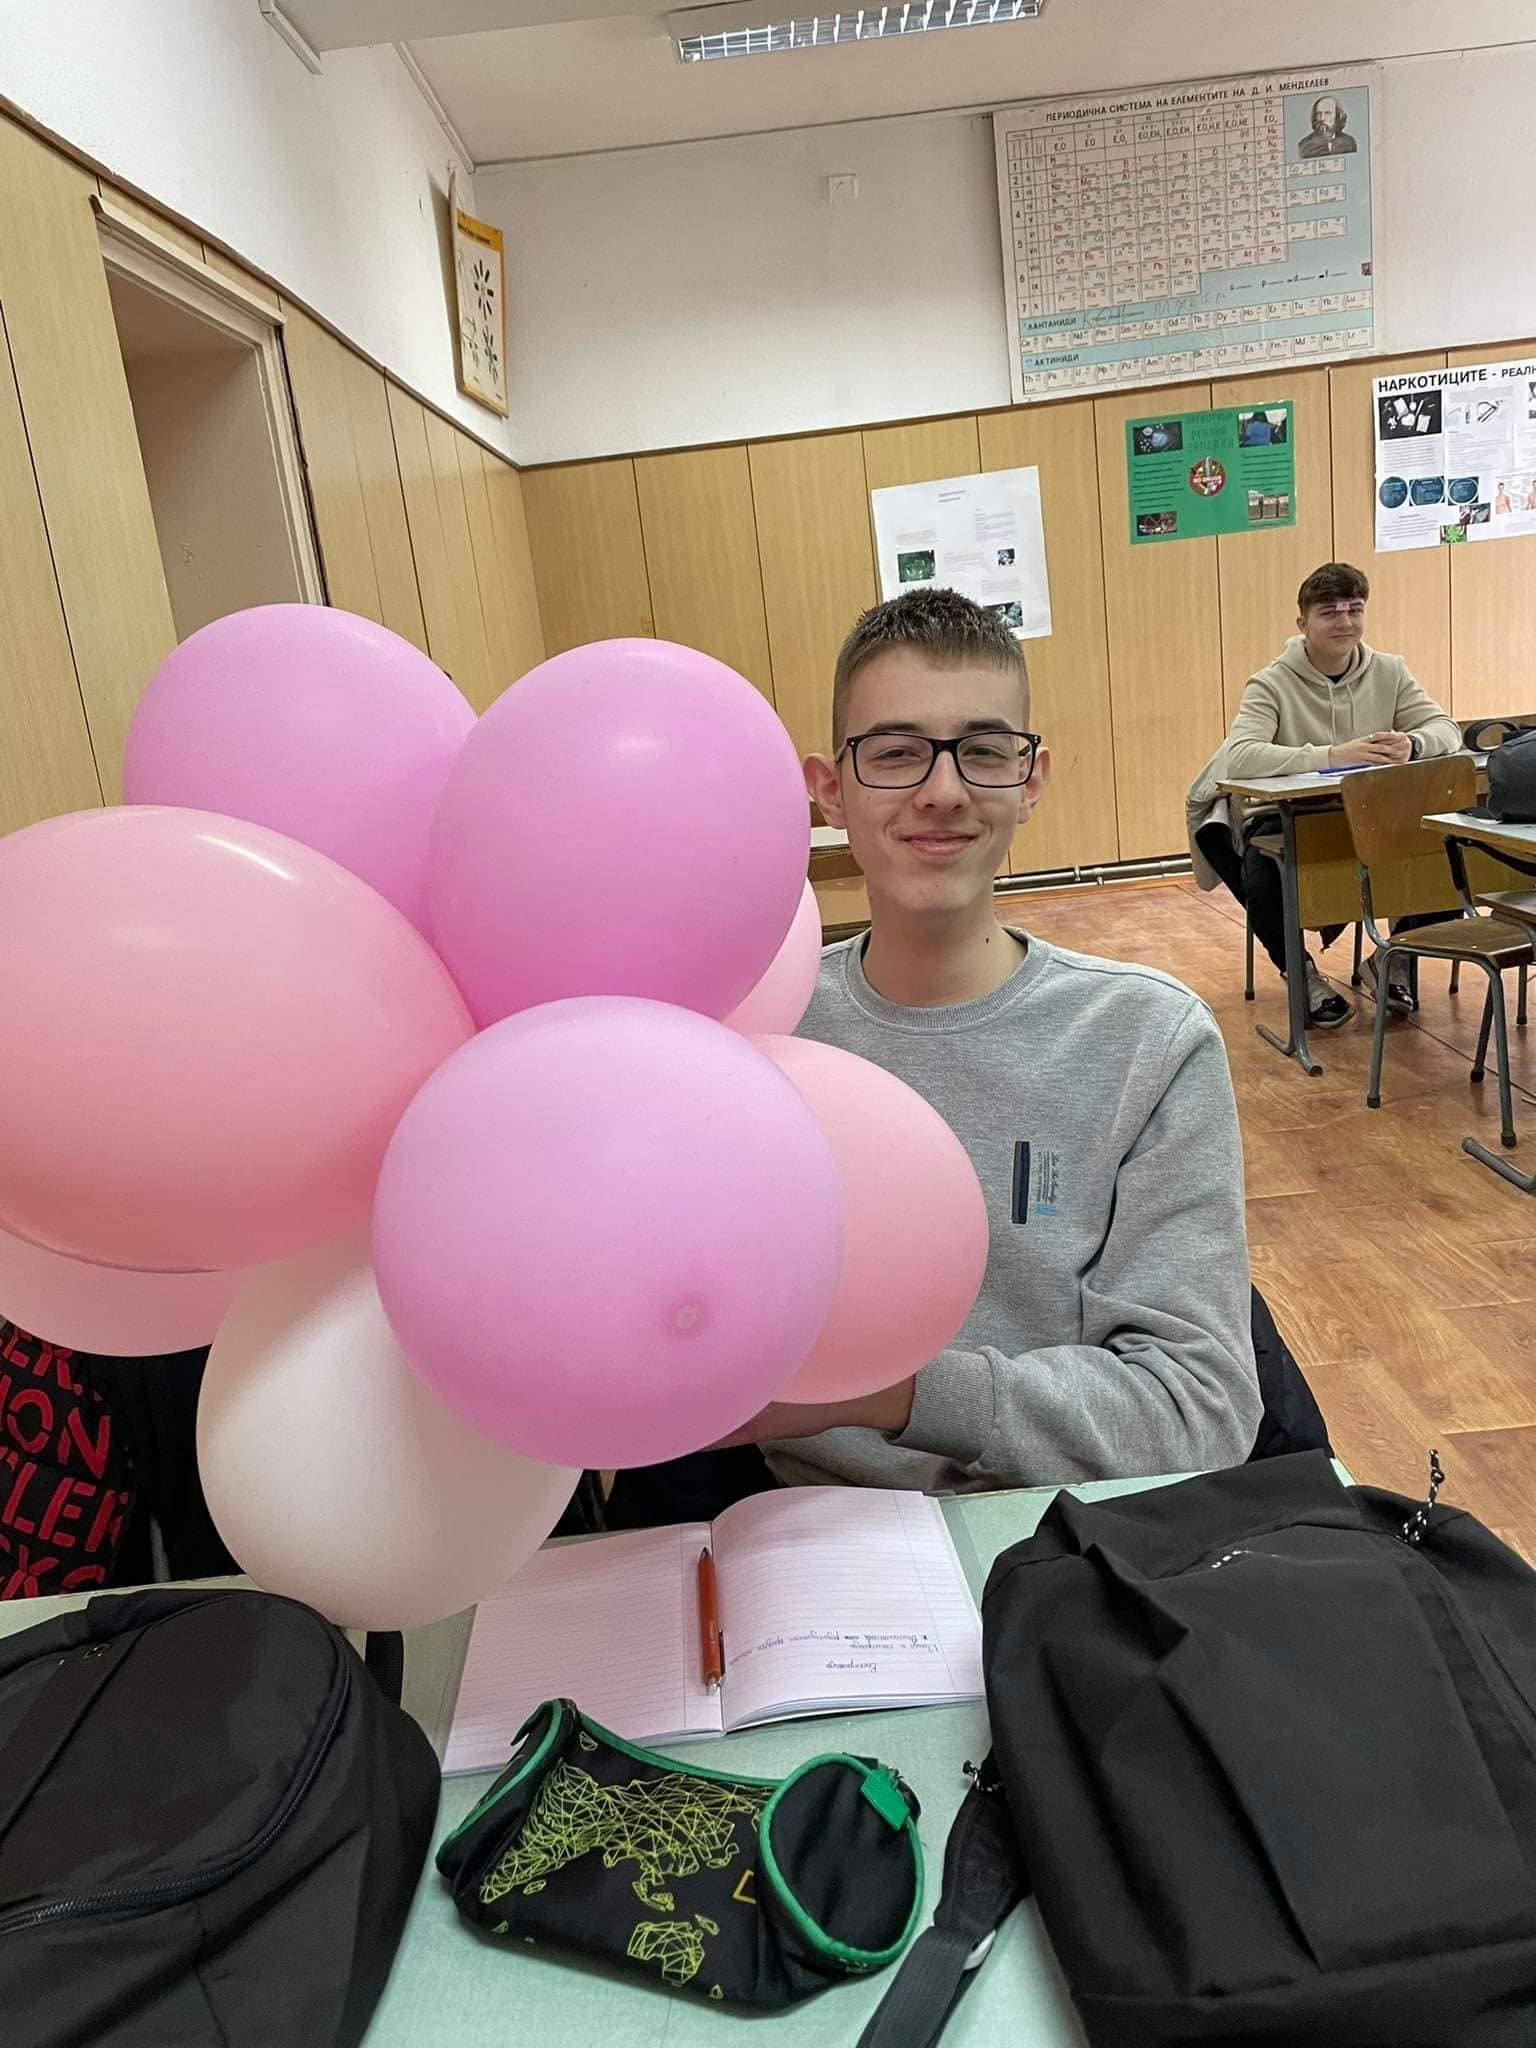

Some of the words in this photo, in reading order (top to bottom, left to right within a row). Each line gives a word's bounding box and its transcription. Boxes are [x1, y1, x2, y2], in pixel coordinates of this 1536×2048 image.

[1046, 106, 1107, 122] ПЕРИОДИЧНА
[1109, 100, 1152, 114] СИСТЕМА
[1156, 97, 1169, 107] НА
[1171, 90, 1228, 105] ЕЛЕМЕНТИТЕ
[1232, 87, 1246, 97] НА
[1279, 77, 1329, 91] МЕНДЕЛЕЕВ
[1378, 369, 1487, 392] НАРКОТИЦИТЕ
